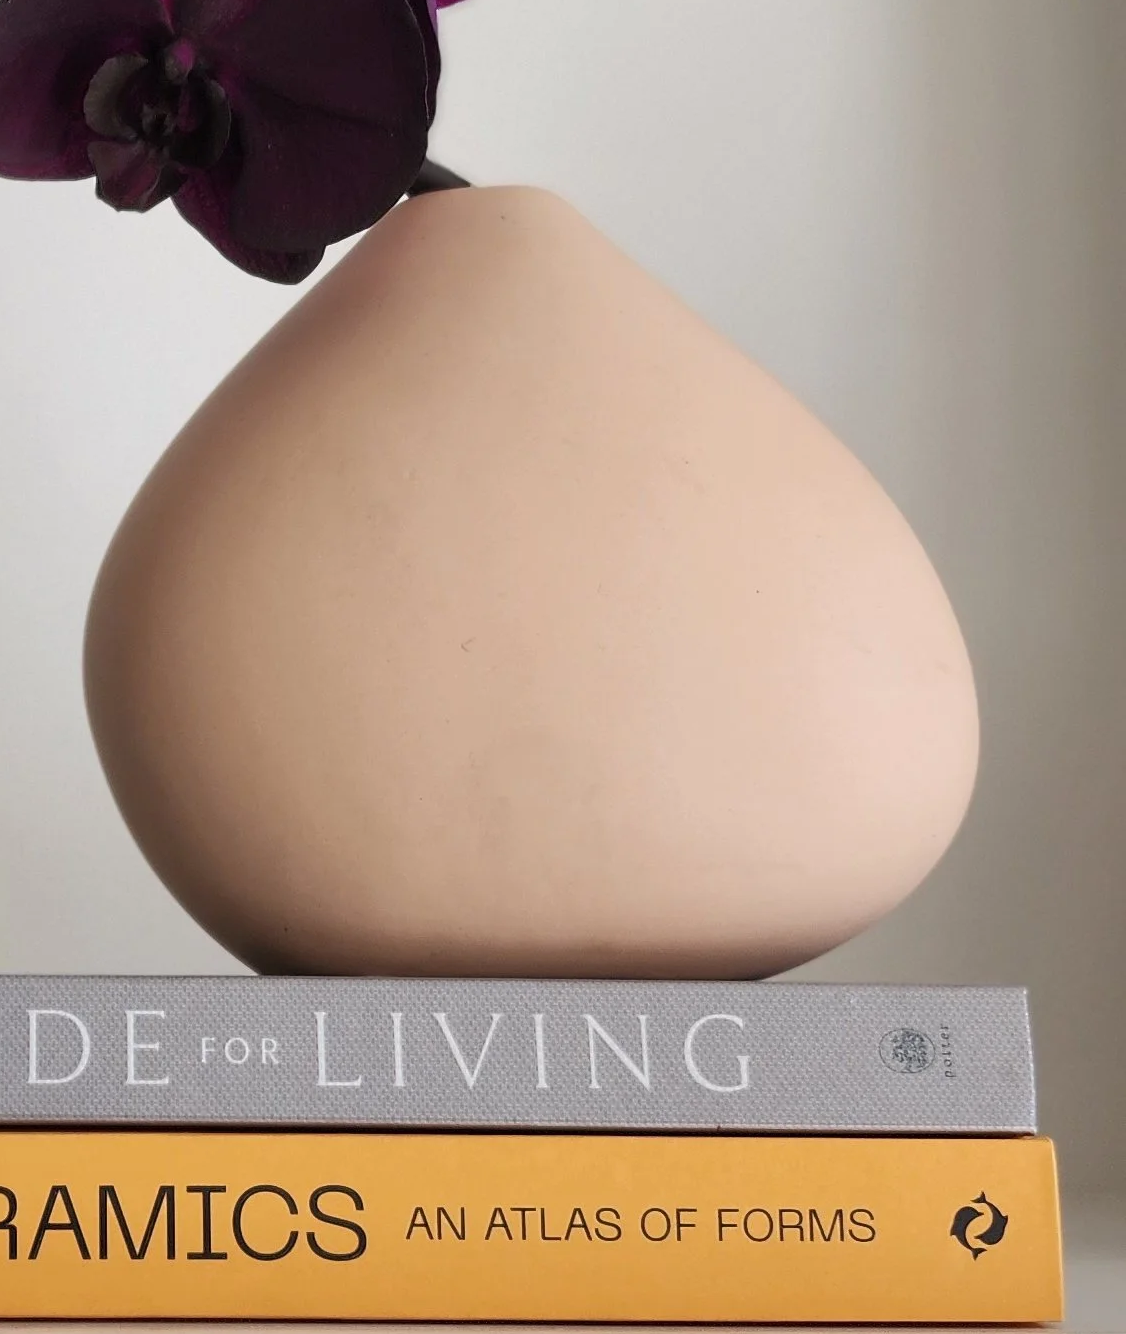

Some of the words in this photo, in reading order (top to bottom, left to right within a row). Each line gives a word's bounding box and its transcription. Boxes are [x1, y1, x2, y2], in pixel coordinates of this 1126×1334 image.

[200, 1037, 280, 1065] FOR
[314, 1010, 751, 1093] LIVING
[405, 1206, 466, 1242] AN
[484, 1206, 623, 1242] ATLAS
[639, 1207, 699, 1243] OF
[716, 1207, 877, 1244] FORMS
